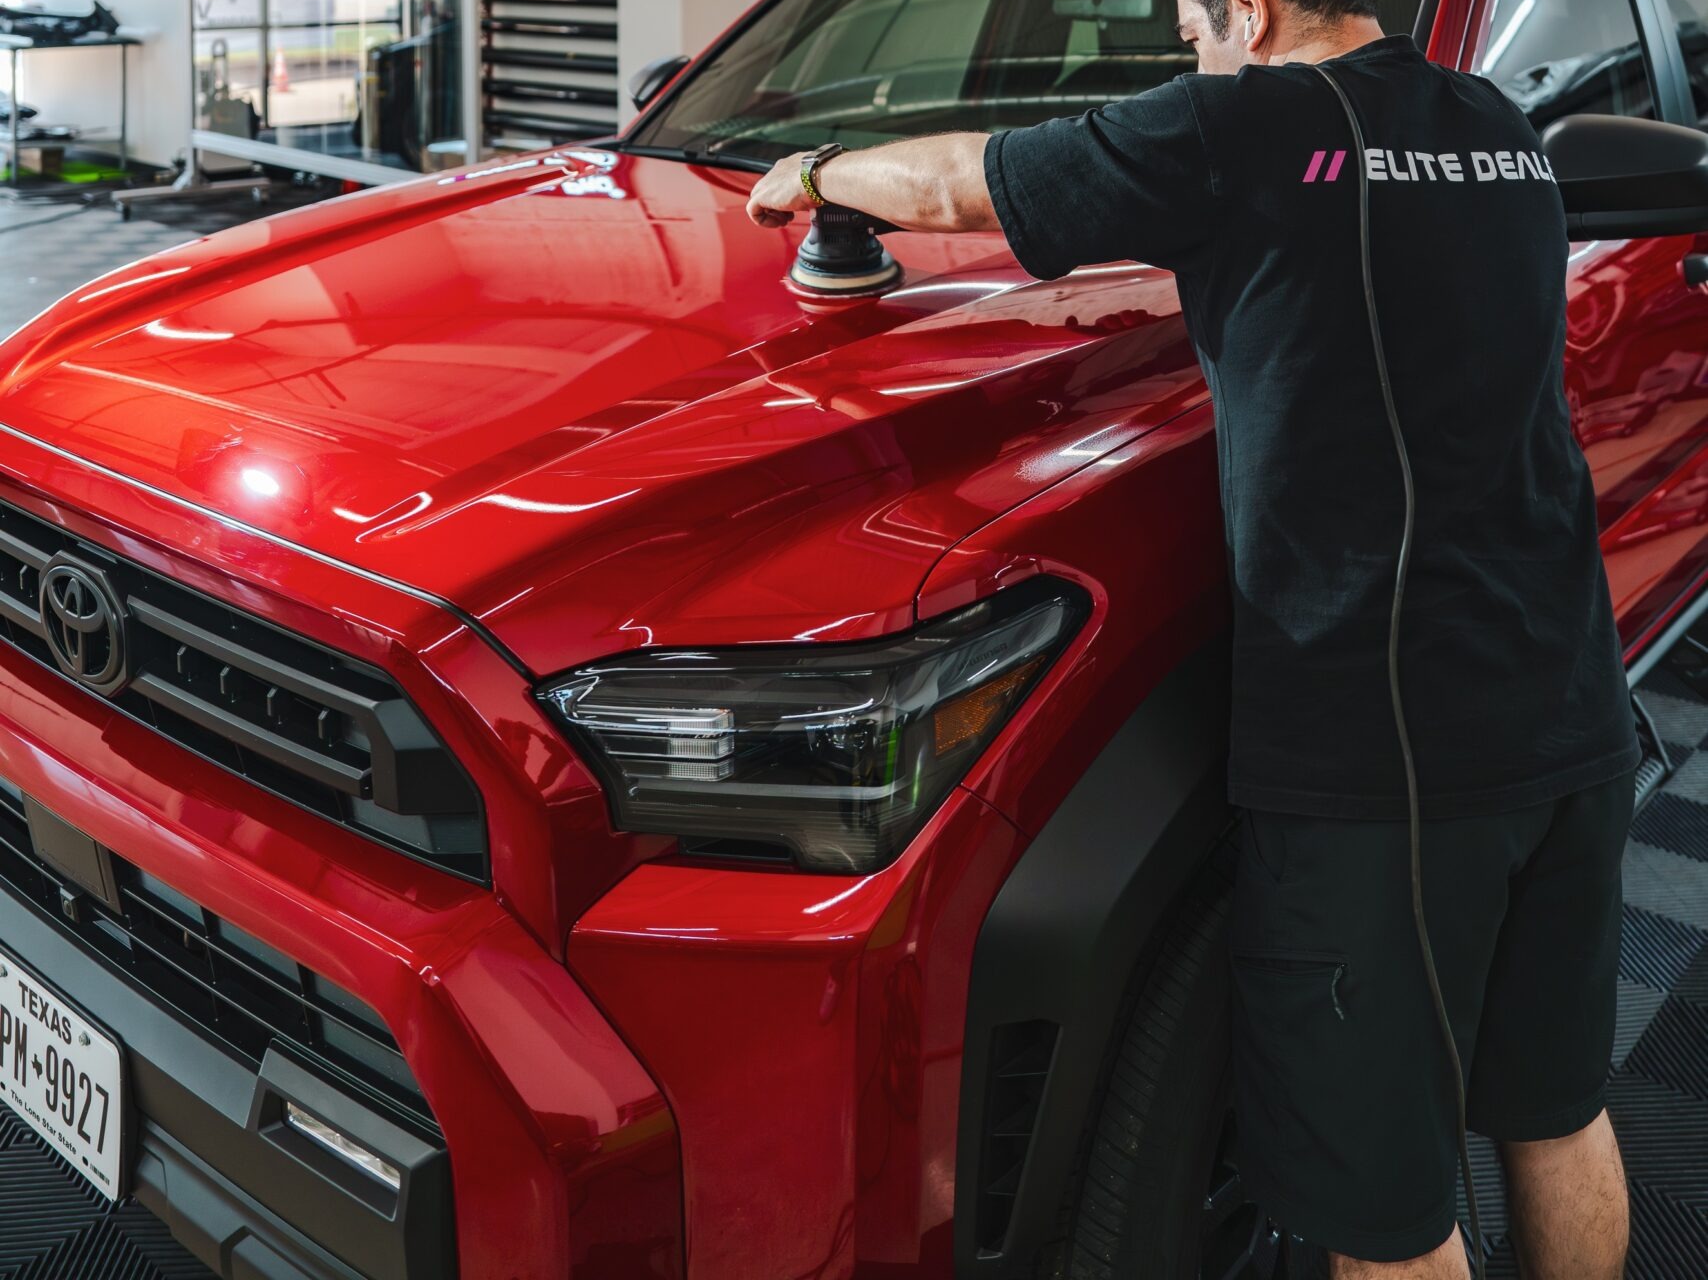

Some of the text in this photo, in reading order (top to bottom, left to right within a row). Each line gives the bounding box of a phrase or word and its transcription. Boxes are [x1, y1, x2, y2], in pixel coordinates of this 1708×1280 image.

[1364, 148, 1464, 181] ELITE
[18, 979, 72, 1045] TEXAS
[10, 1089, 77, 1155] The Lone Star State
[45, 1044, 109, 1155] 9927
